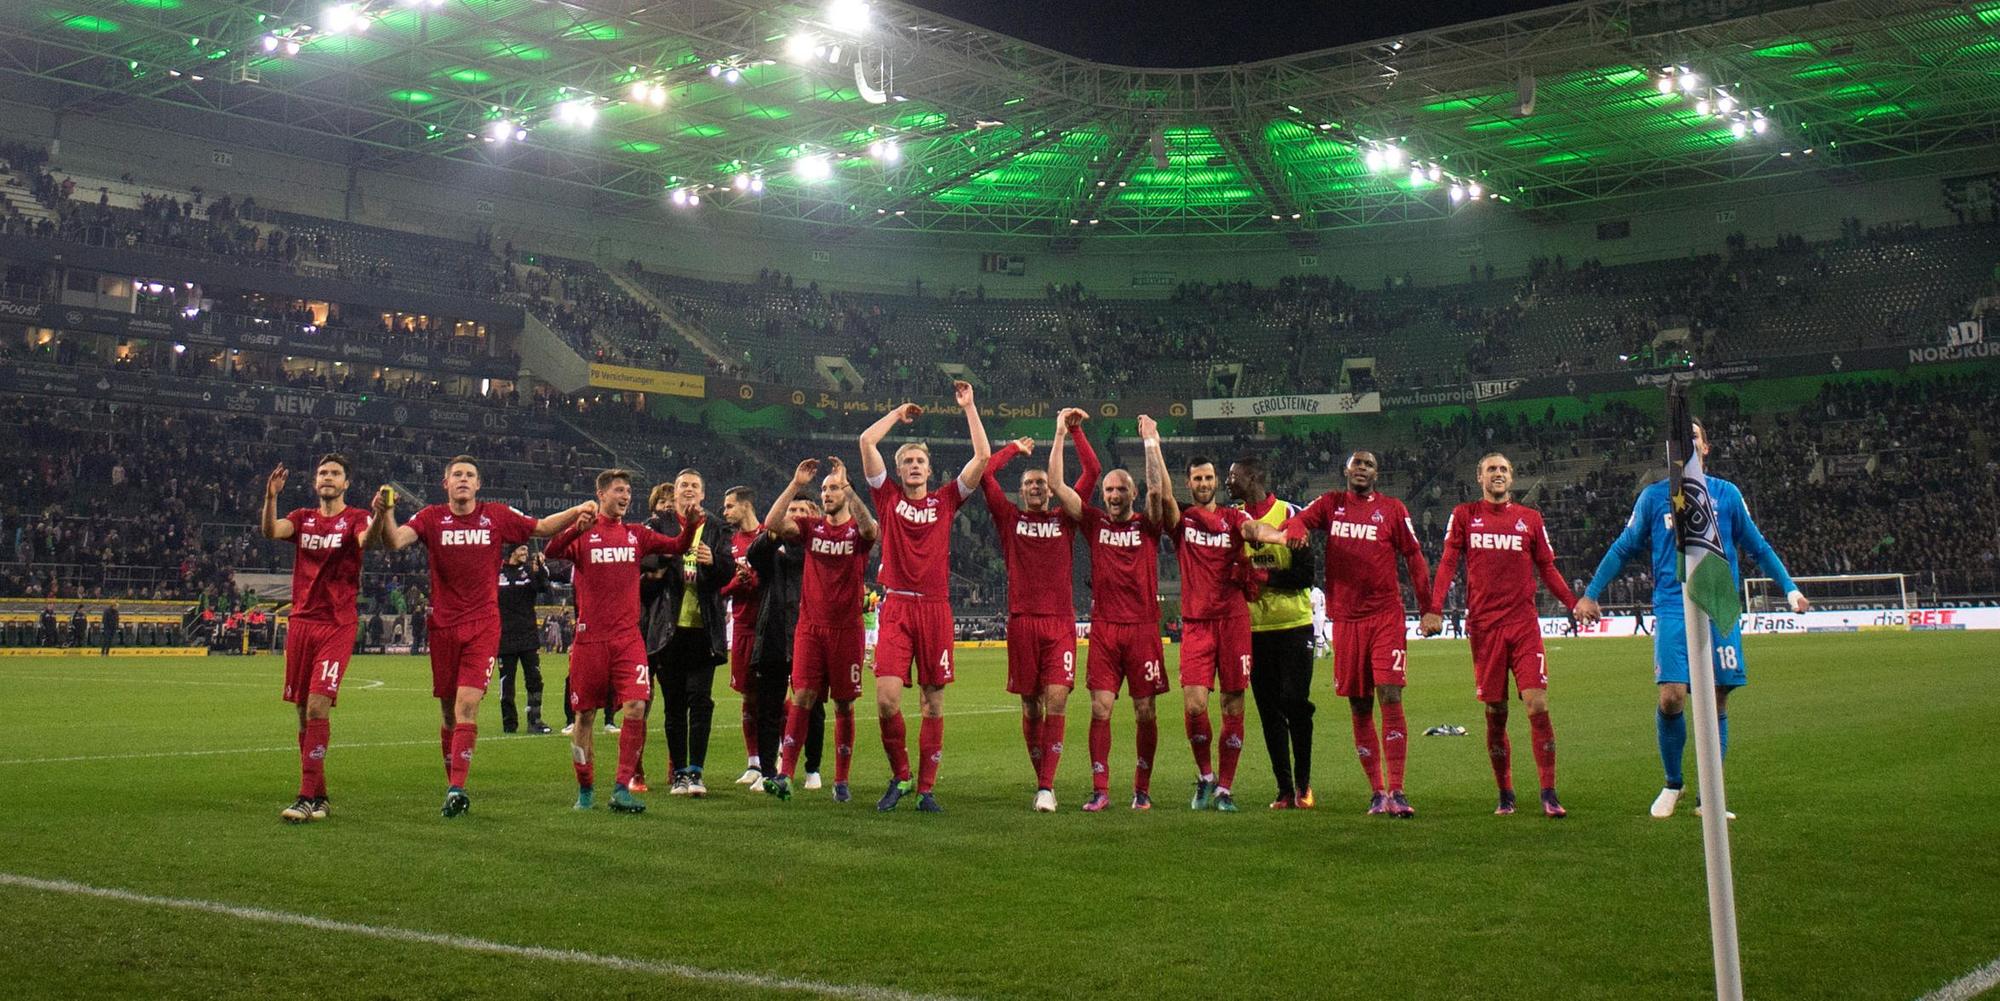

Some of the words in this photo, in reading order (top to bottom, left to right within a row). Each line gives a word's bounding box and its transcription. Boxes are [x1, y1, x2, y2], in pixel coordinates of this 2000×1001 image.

[274, 394, 317, 415] NEW
[1252, 396, 1320, 416] GEROLSTEINER
[1379, 387, 1472, 406] www.fanproje
[896, 500, 938, 524] REWE
[441, 529, 491, 546] REWE
[1016, 521, 1062, 538] REWE
[1099, 528, 1142, 547] REWE
[1184, 526, 1231, 548] REWE
[1331, 520, 1378, 541] REWE
[301, 533, 343, 550] REWE
[811, 537, 853, 556] REWE
[1470, 532, 1523, 551] REWE
[590, 546, 636, 564] REWE
[485, 656, 495, 677] 3
[939, 648, 951, 671] 4
[1063, 650, 1074, 673] 9
[1716, 646, 1737, 669] 18
[321, 659, 339, 682] 14
[849, 663, 861, 684] 6
[1144, 660, 1162, 682] 34
